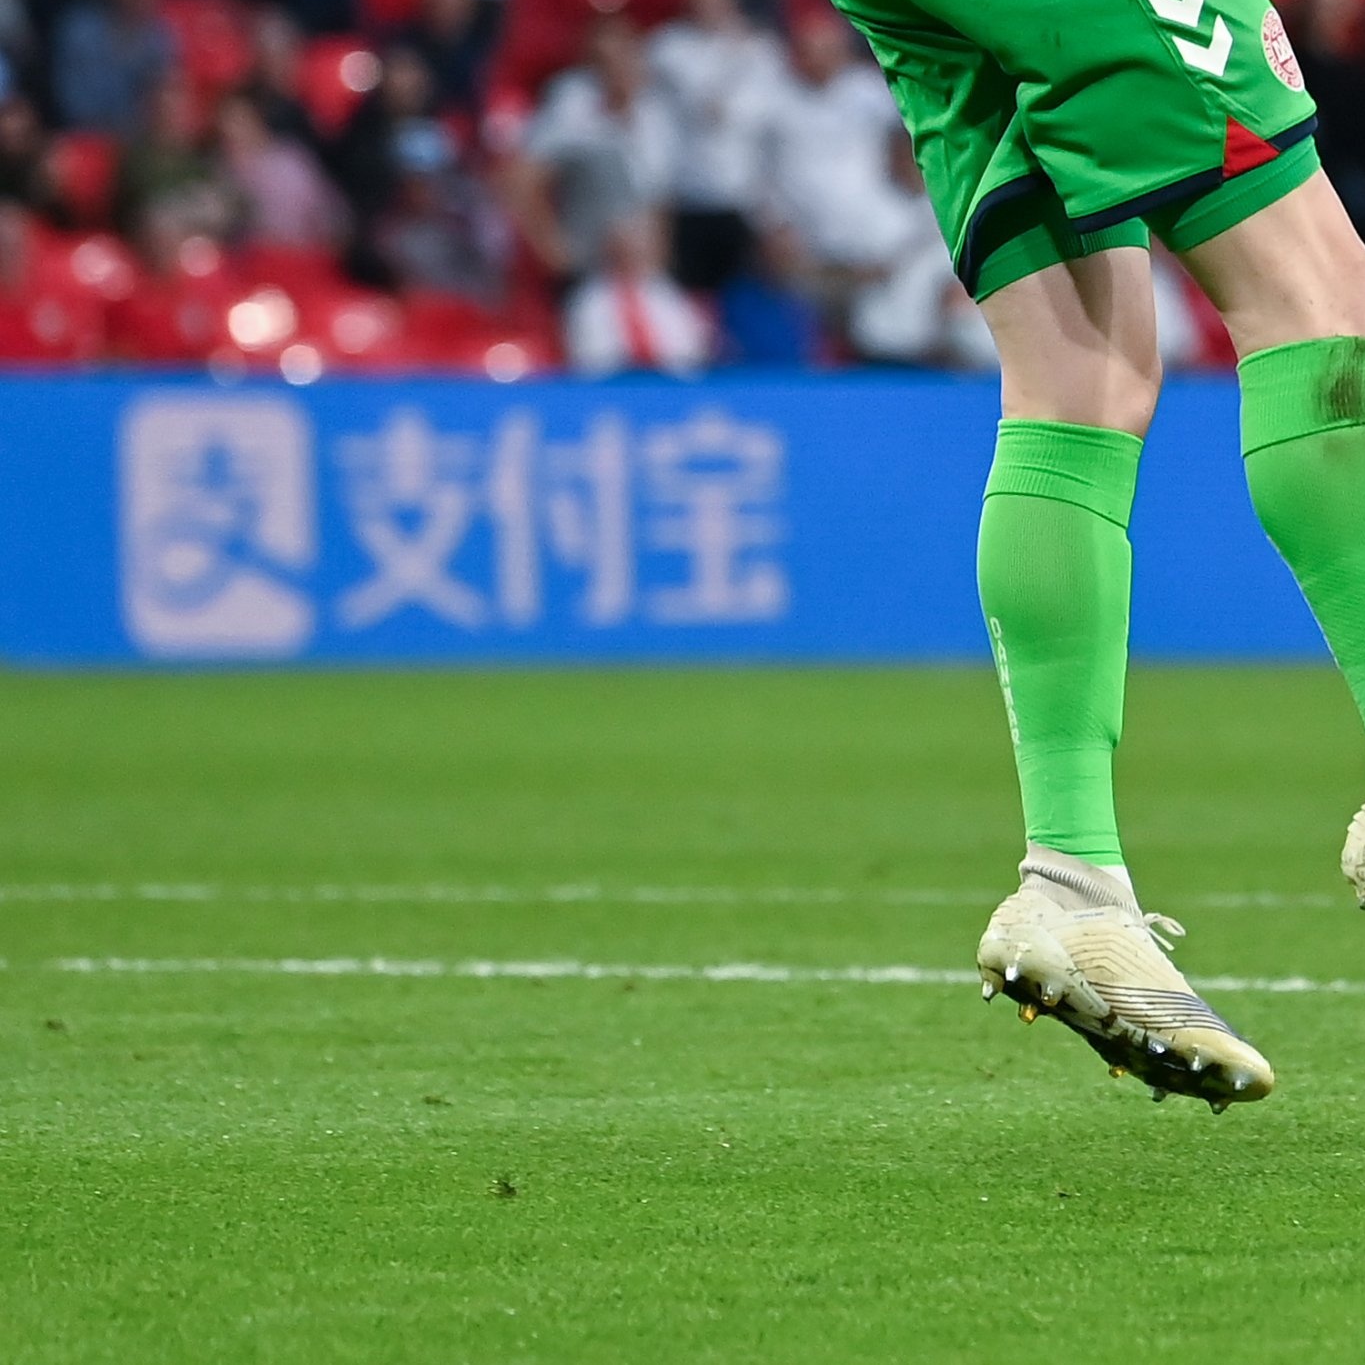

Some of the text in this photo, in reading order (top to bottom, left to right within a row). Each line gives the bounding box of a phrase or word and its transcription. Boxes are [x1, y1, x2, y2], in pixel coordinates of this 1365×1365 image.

[333, 409, 788, 629] 支付宝
[990, 616, 1020, 745] DANMAR
